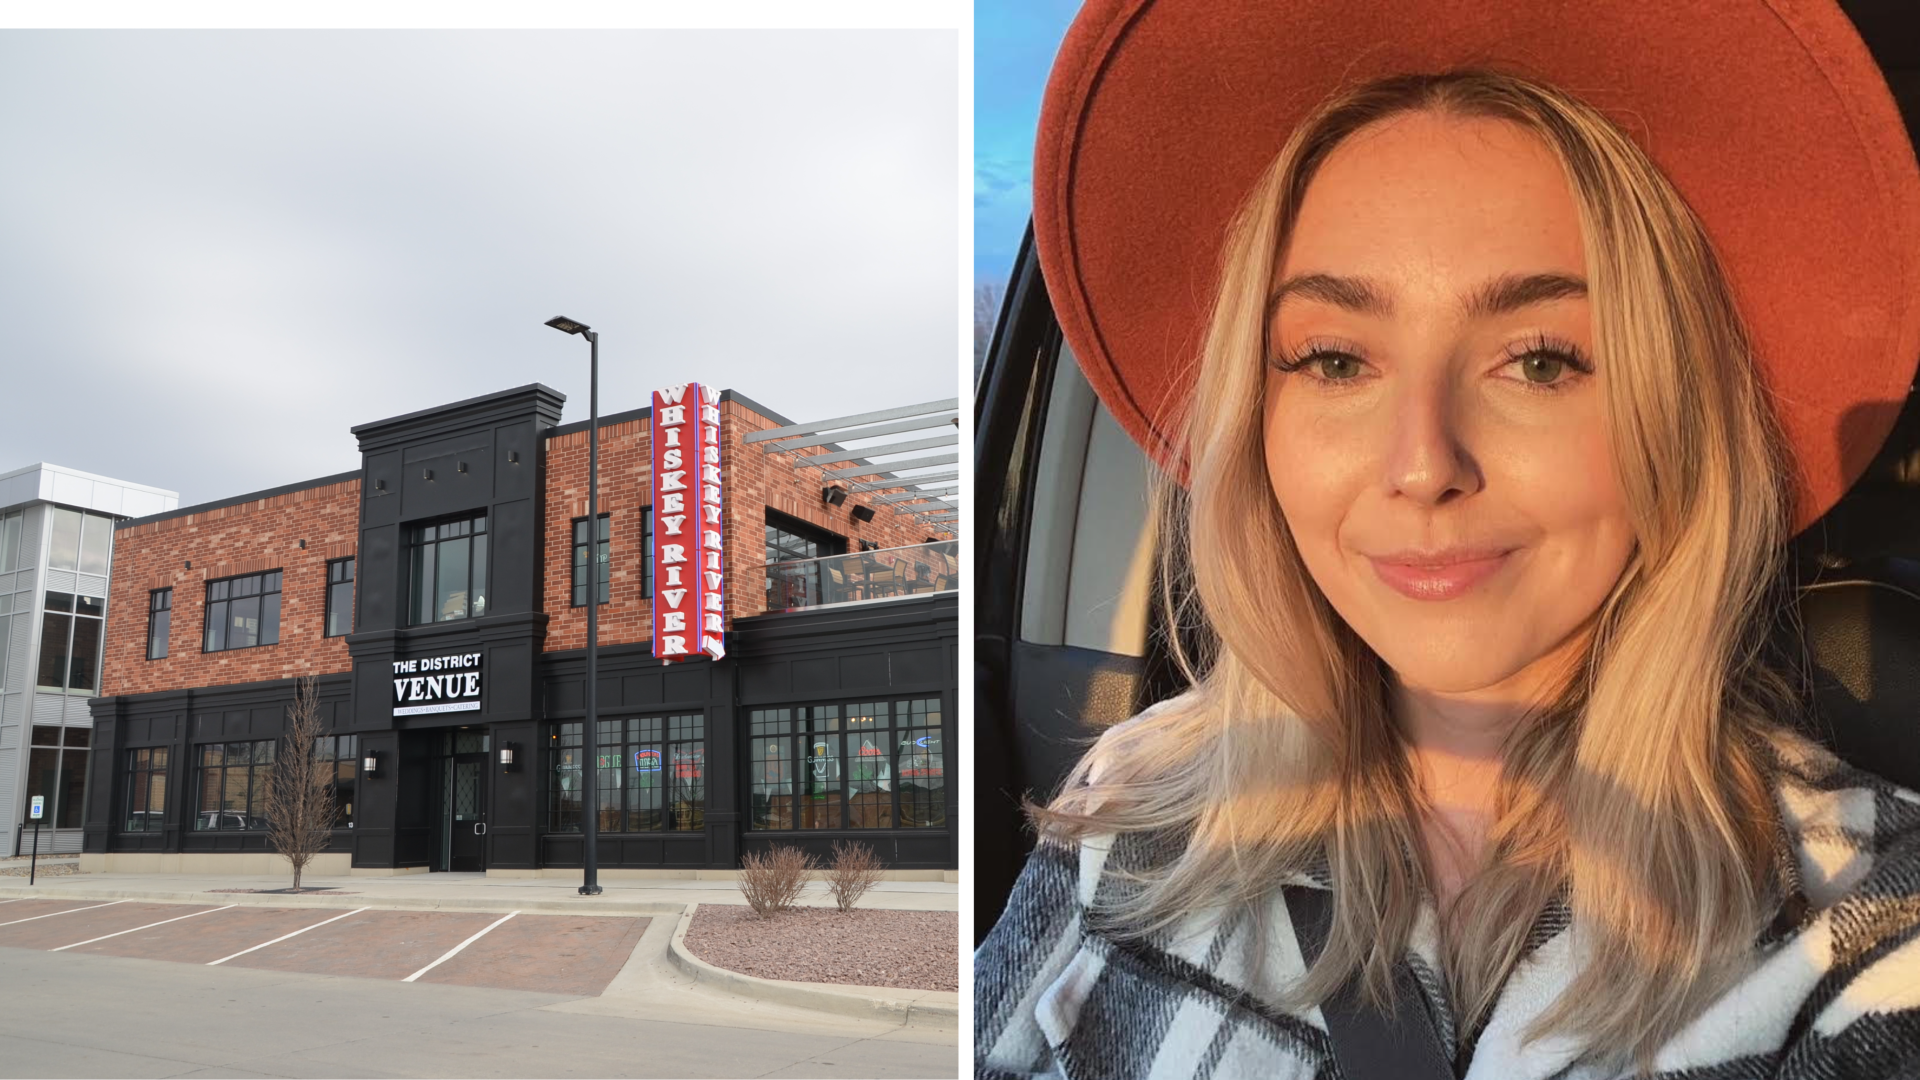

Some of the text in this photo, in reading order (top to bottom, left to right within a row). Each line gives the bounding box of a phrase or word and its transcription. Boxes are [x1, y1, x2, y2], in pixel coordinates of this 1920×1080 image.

[658, 383, 688, 655] WHISKEY RIVER
[700, 384, 724, 633] WHISKEY RIVER
[393, 653, 481, 673] THE DISTRICT
[393, 671, 480, 702] VENUE
[858, 746, 882, 756] Coors
